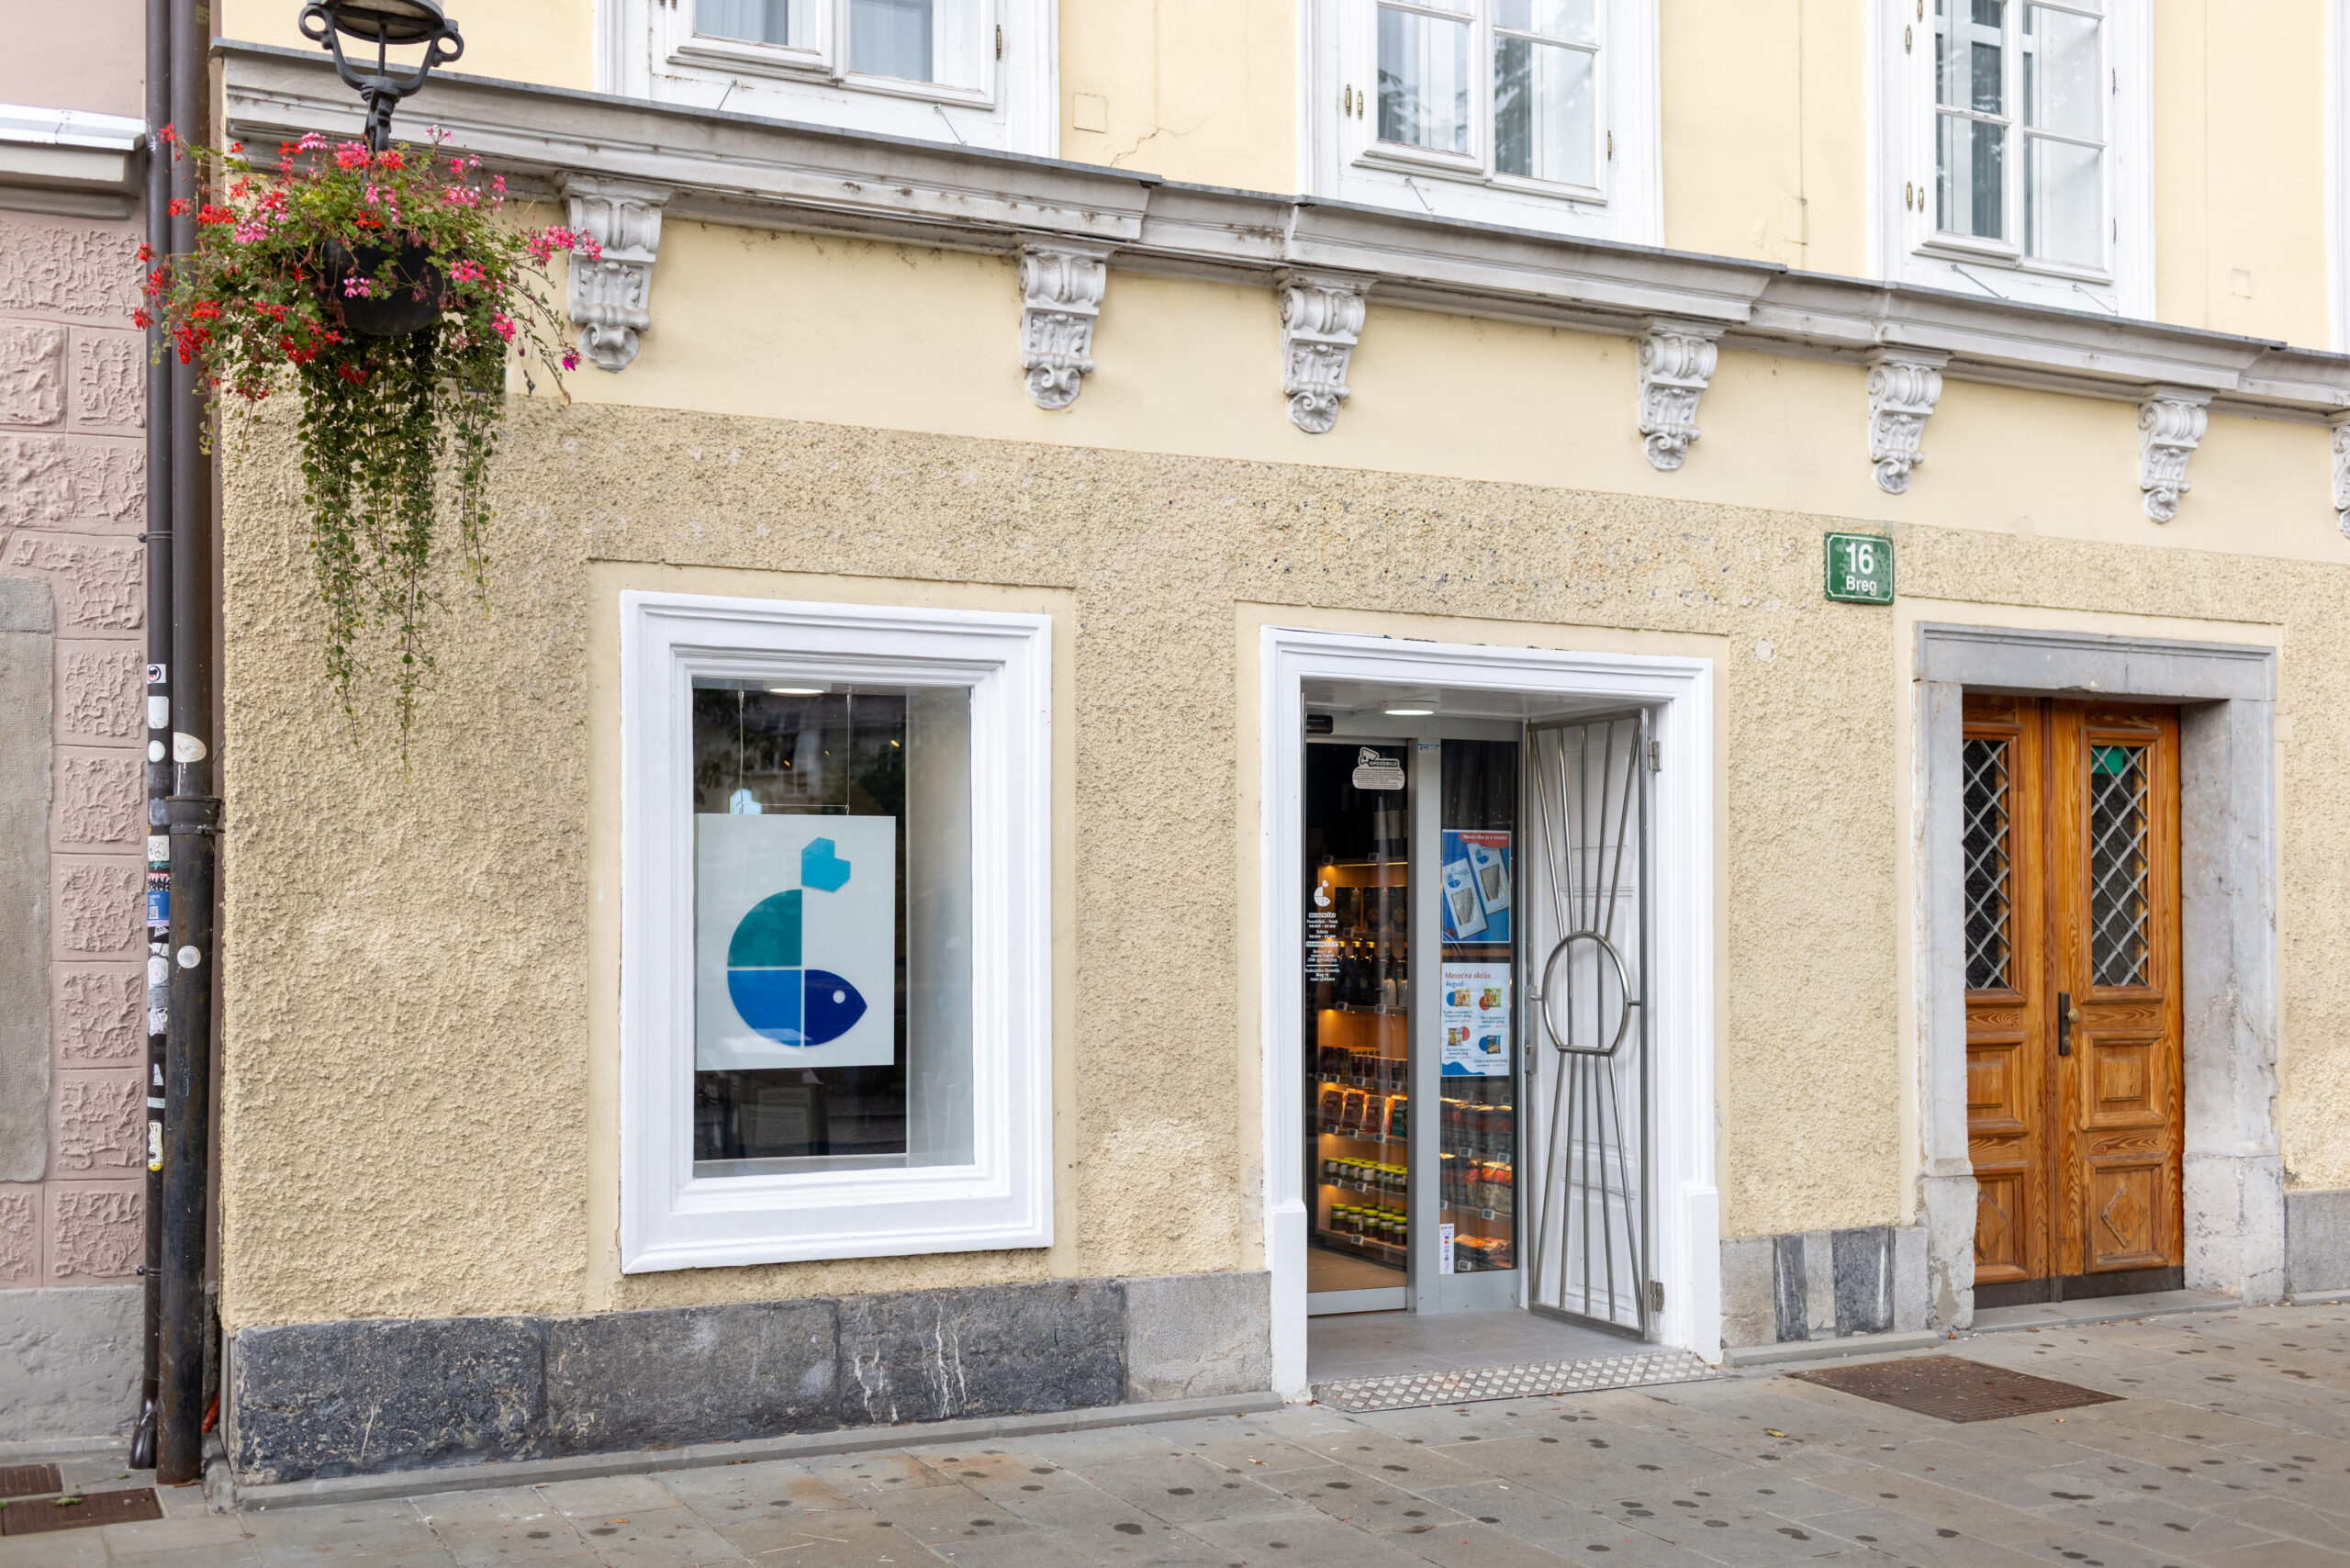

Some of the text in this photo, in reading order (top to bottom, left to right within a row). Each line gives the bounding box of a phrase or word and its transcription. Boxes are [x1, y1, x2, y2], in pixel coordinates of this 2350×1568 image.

[1846, 543, 1874, 575] 16
[1846, 576, 1877, 596] Breg
[1473, 972, 1491, 980] akcija
